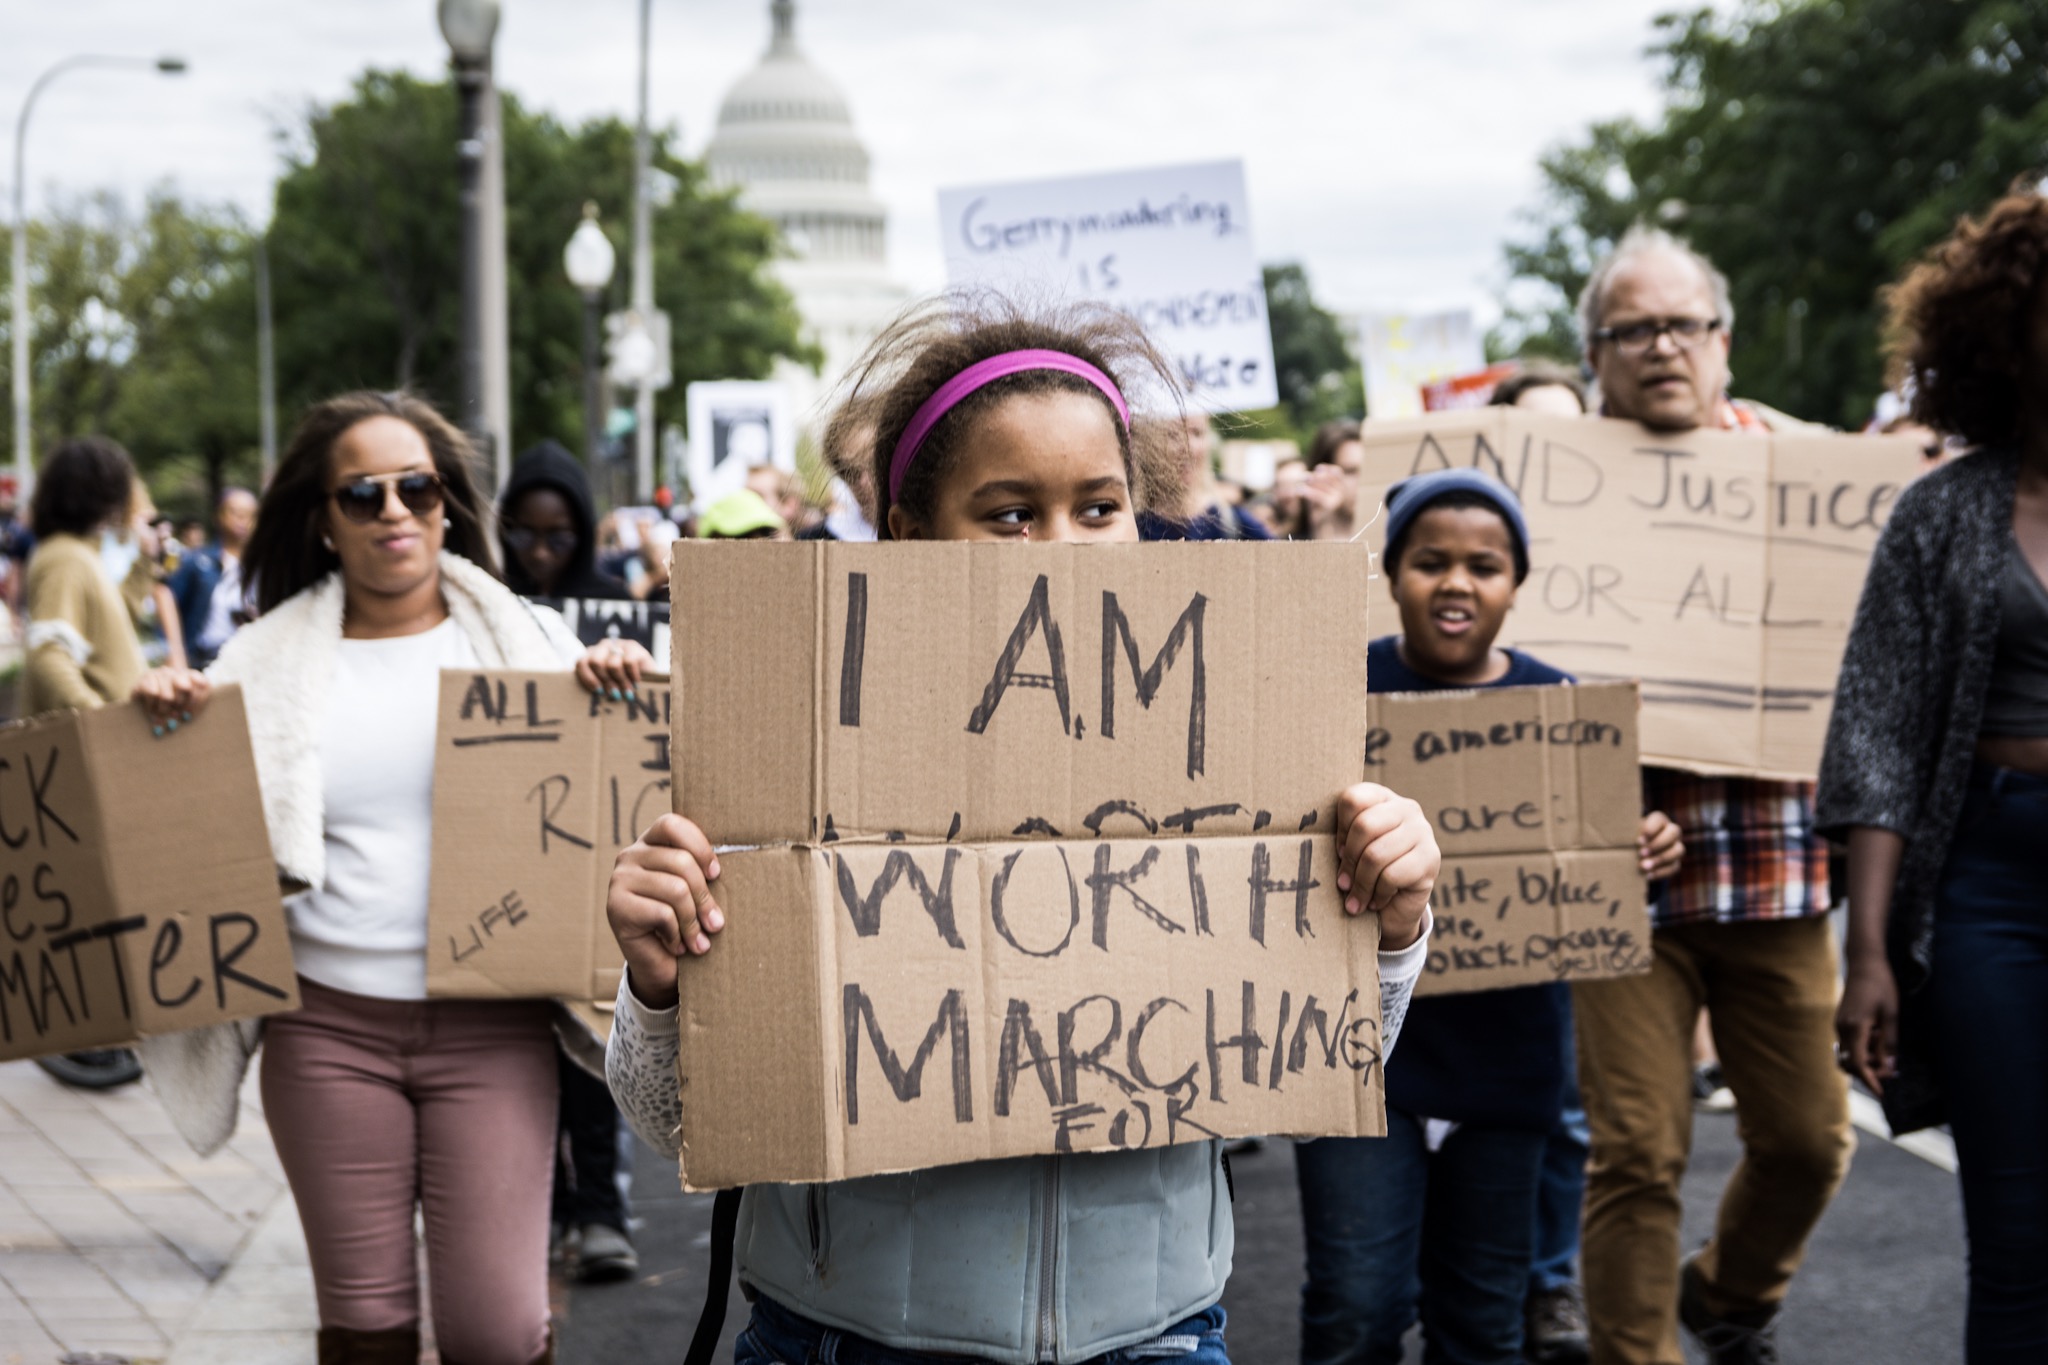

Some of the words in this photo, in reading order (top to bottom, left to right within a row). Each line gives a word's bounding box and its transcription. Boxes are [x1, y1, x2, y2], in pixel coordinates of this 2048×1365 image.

[1674, 563, 1824, 628] ALL
[838, 572, 868, 727] I
[460, 674, 563, 727] ALL
[1413, 716, 1622, 764] american
[812, 799, 1321, 958] WORTH
[1431, 866, 1511, 920] ite,
[1516, 866, 1622, 918] blue,
[448, 889, 529, 963] LIFE
[842, 979, 1382, 1125] MARCHING
[1051, 1081, 1223, 1152] FOR
